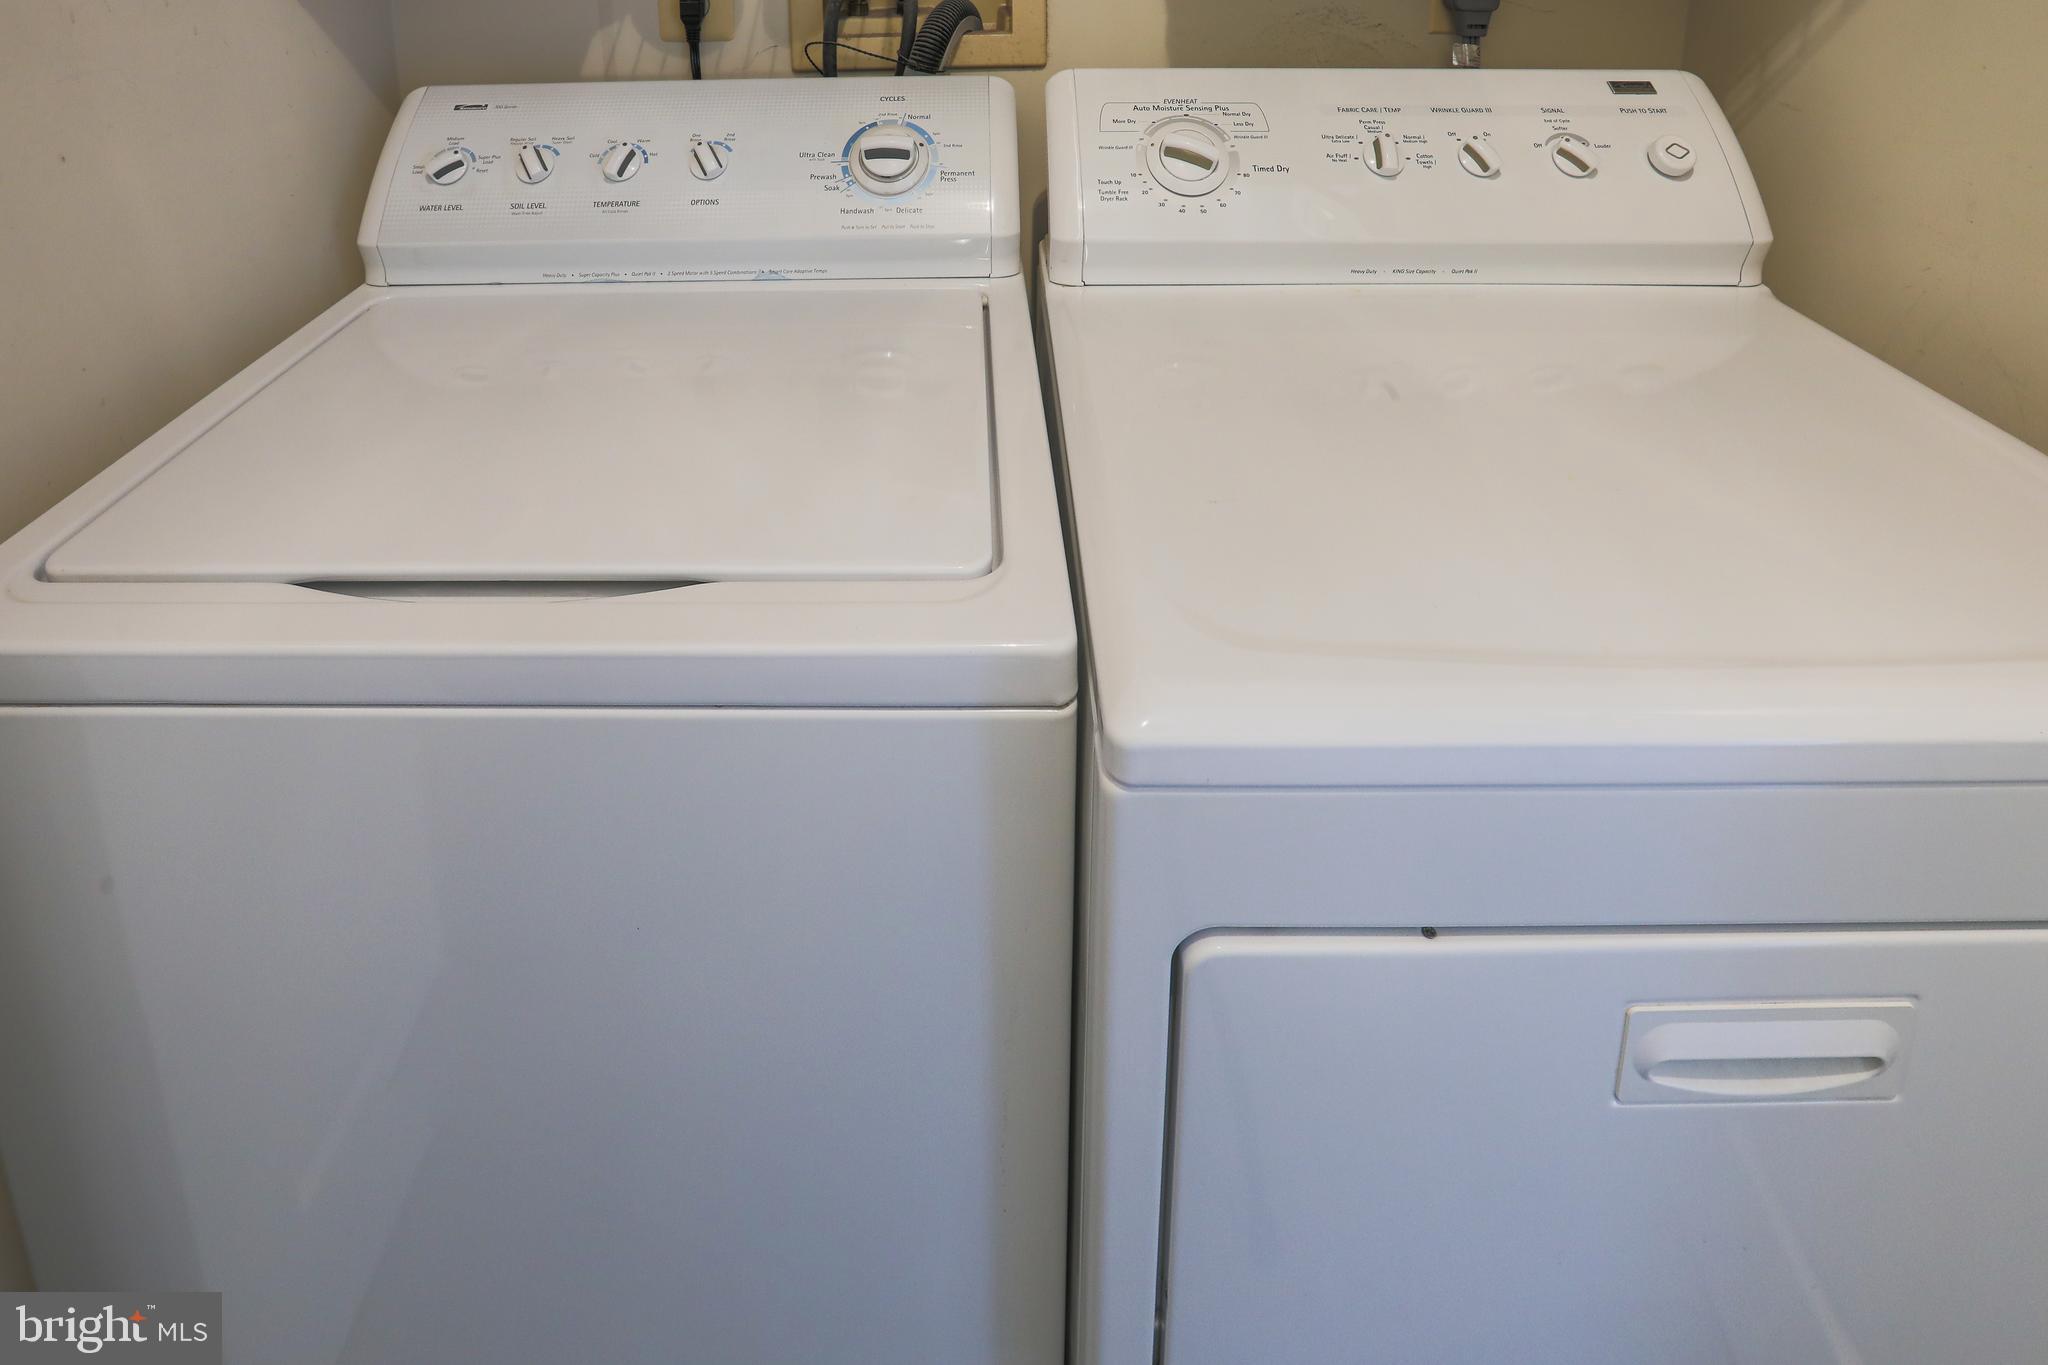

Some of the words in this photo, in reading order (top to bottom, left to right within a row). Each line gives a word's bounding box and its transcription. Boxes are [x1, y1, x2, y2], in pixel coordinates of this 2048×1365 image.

[1252, 164, 1275, 172] Timed
[1276, 164, 1290, 173] Dry
[593, 200, 640, 208] TEMPERATURE
